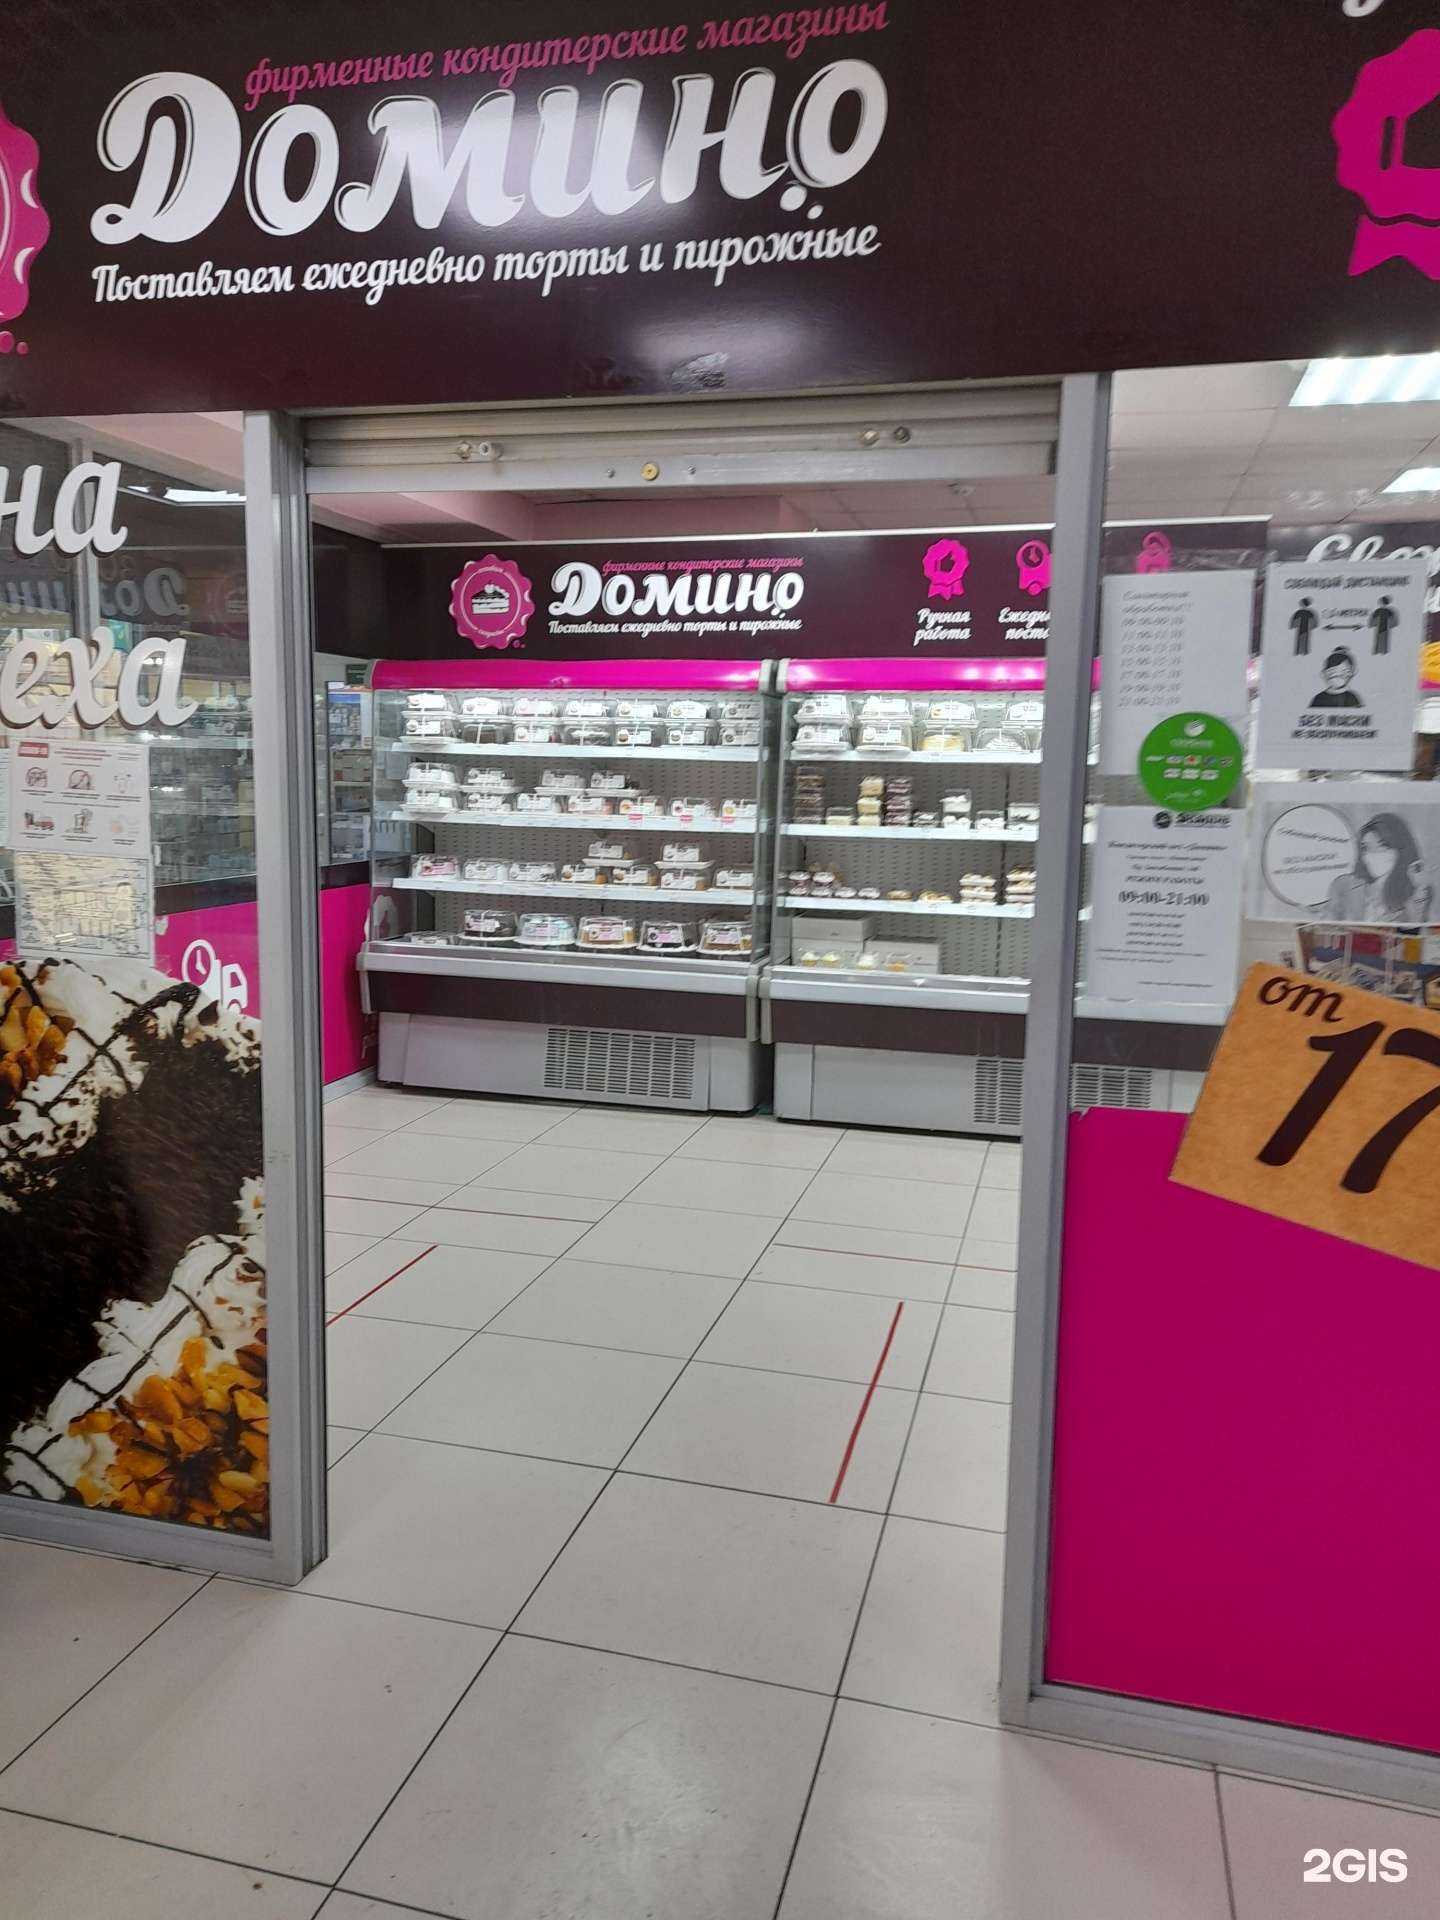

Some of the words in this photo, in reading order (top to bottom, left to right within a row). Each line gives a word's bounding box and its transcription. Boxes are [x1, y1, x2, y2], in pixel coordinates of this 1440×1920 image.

[244, 57, 434, 111] фирменные
[442, 25, 688, 88] кондитерские
[697, 1, 890, 58] магазины
[90, 59, 888, 244] Домино
[92, 261, 295, 302] Поставляем
[301, 246, 485, 306] ежедневно
[493, 244, 629, 297] торты
[639, 243, 664, 272] и
[673, 225, 882, 287] пирожные
[548, 561, 804, 618] Домино
[917, 607, 973, 629] Ручная
[548, 620, 619, 634] Поставляем
[621, 620, 683, 638] ежедневно
[683, 621, 728, 637] торты
[739, 619, 803, 636] пирожные
[913, 627, 973, 647] работа
[1259, 976, 1347, 1022] от
[1256, 1021, 1440, 1194] 17
